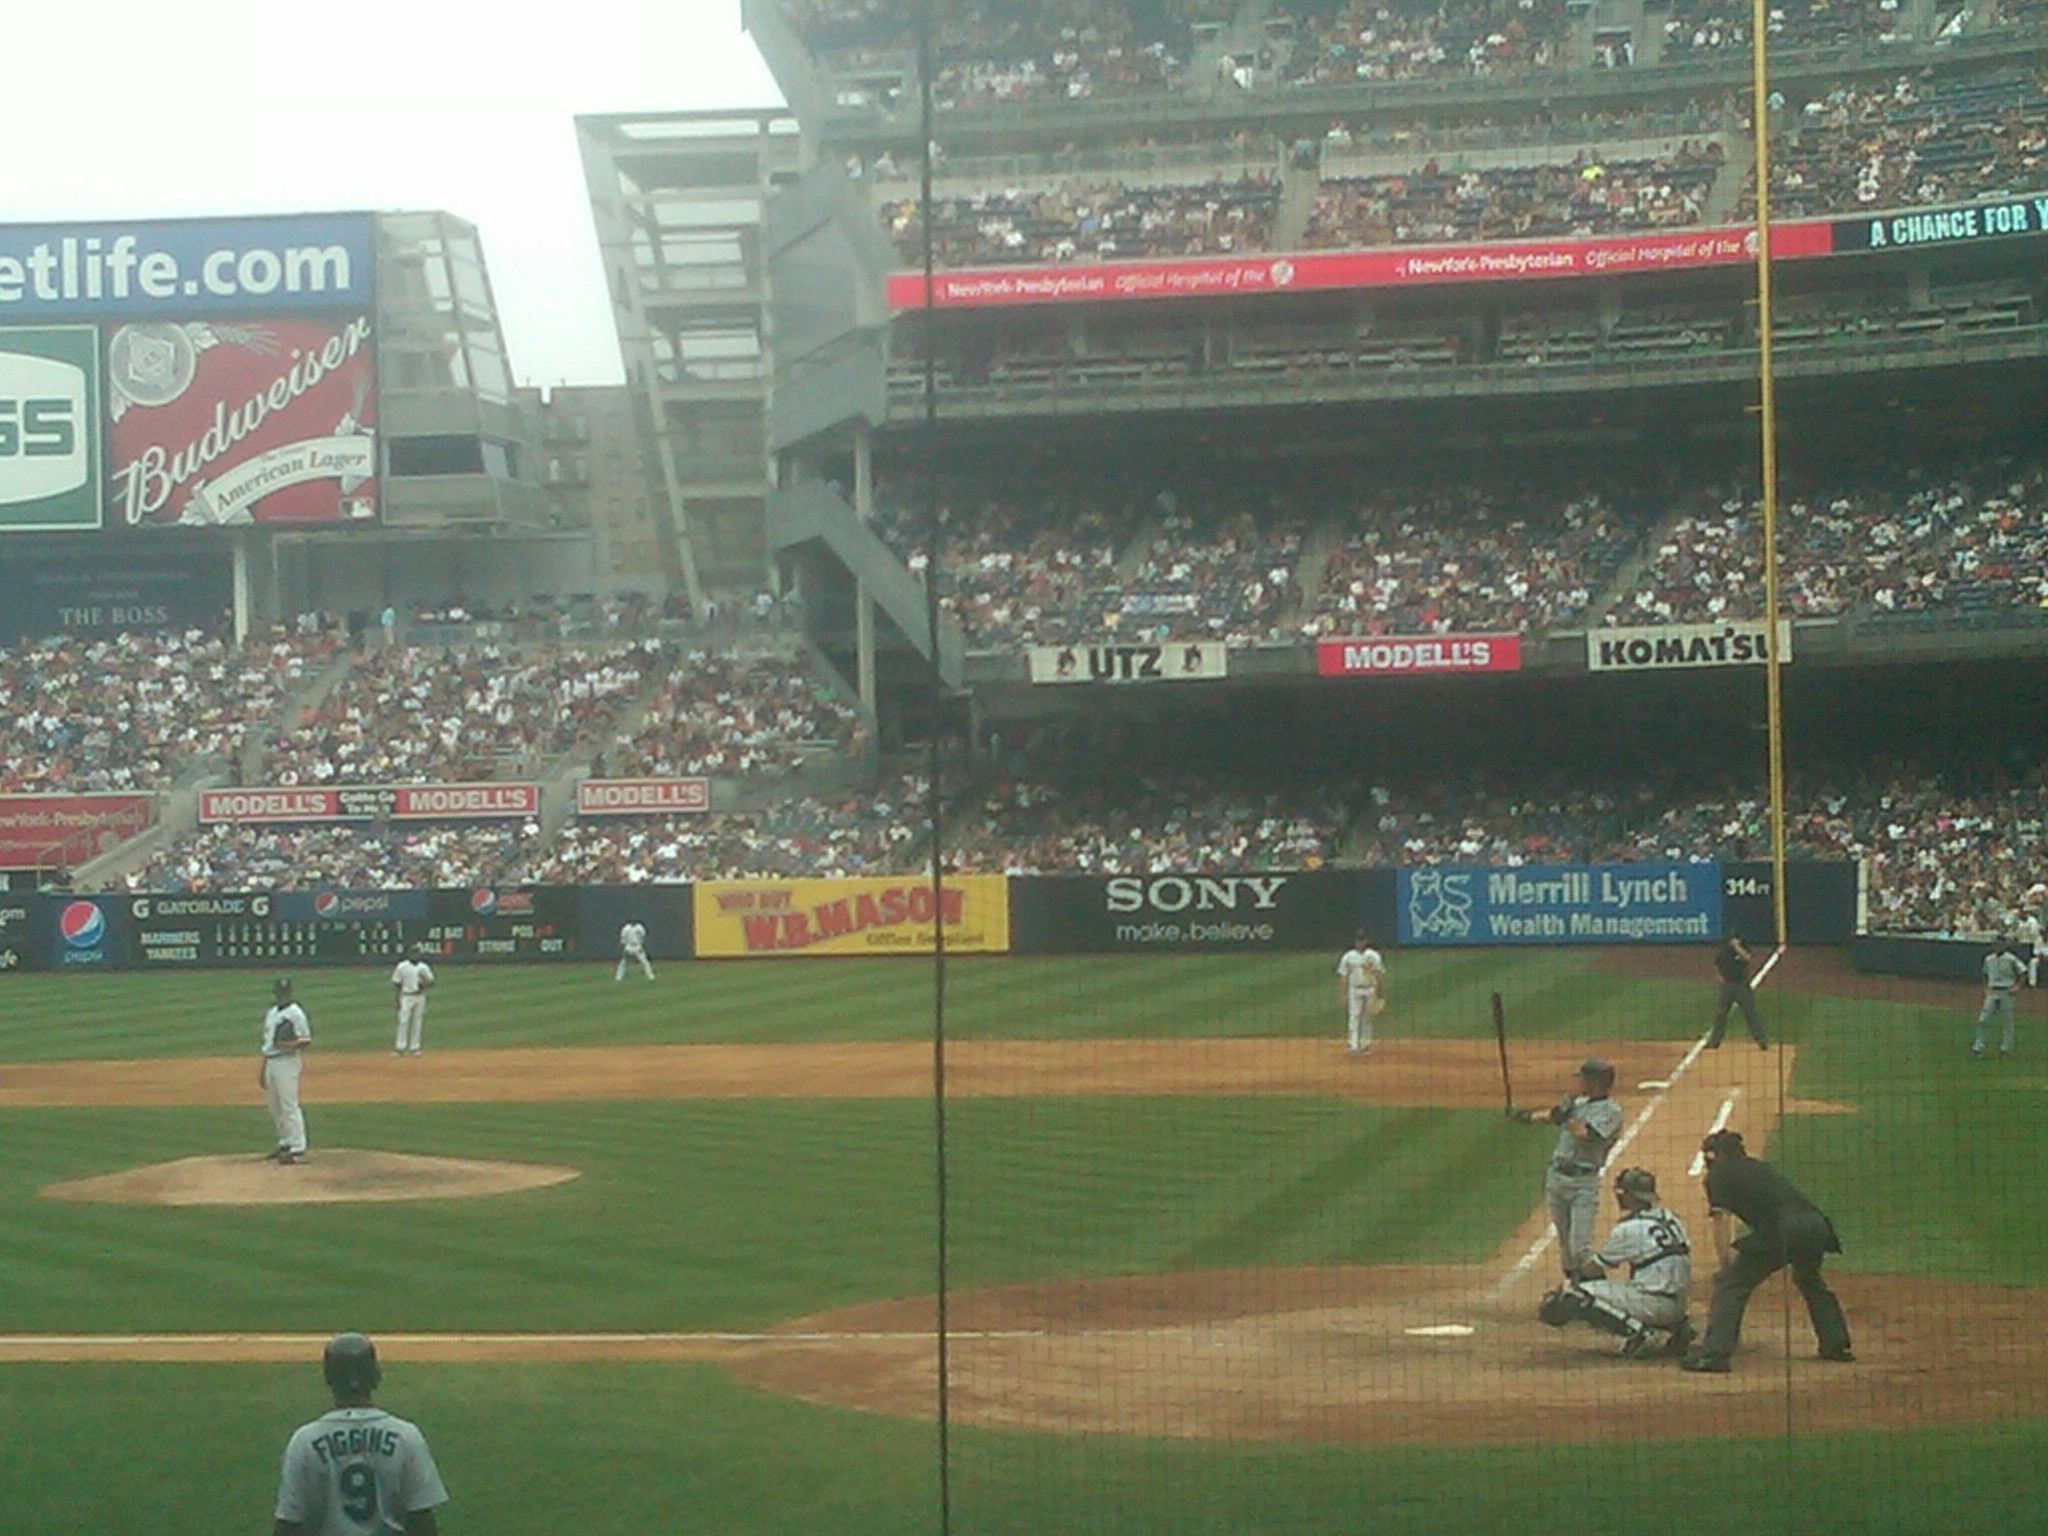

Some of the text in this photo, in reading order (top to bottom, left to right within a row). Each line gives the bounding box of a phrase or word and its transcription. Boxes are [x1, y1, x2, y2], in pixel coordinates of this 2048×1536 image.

[1870, 221, 1887, 247] A
[1891, 210, 1978, 244] CHANCE
[1983, 205, 2028, 234] FOR
[1638, 243, 1696, 263] Hospital
[1698, 240, 1714, 257] of
[1716, 239, 1740, 254] the
[1225, 269, 1241, 288] of
[110, 315, 371, 525] Budweiser
[216, 453, 304, 512] American
[309, 449, 367, 471] Lager
[59, 606, 168, 625] THE BOSS
[1344, 642, 1490, 669] MODELL'S
[1601, 628, 1770, 666] KOMATSU
[1088, 647, 1162, 680] UTZ
[210, 788, 527, 815] MODELL'S MODELL'S
[584, 785, 704, 807] MODELL'S
[1105, 877, 1287, 912] SONY
[1488, 870, 1687, 909] Merrill Lynch
[1725, 877, 1756, 898] 314
[132, 896, 269, 919] G GATORADE G
[341, 896, 389, 912] pepsi
[814, 885, 964, 940] MASON
[1488, 911, 1709, 939] Wealth Management
[311, 1427, 399, 1465] FIGGINS
[339, 1461, 378, 1523] 9
